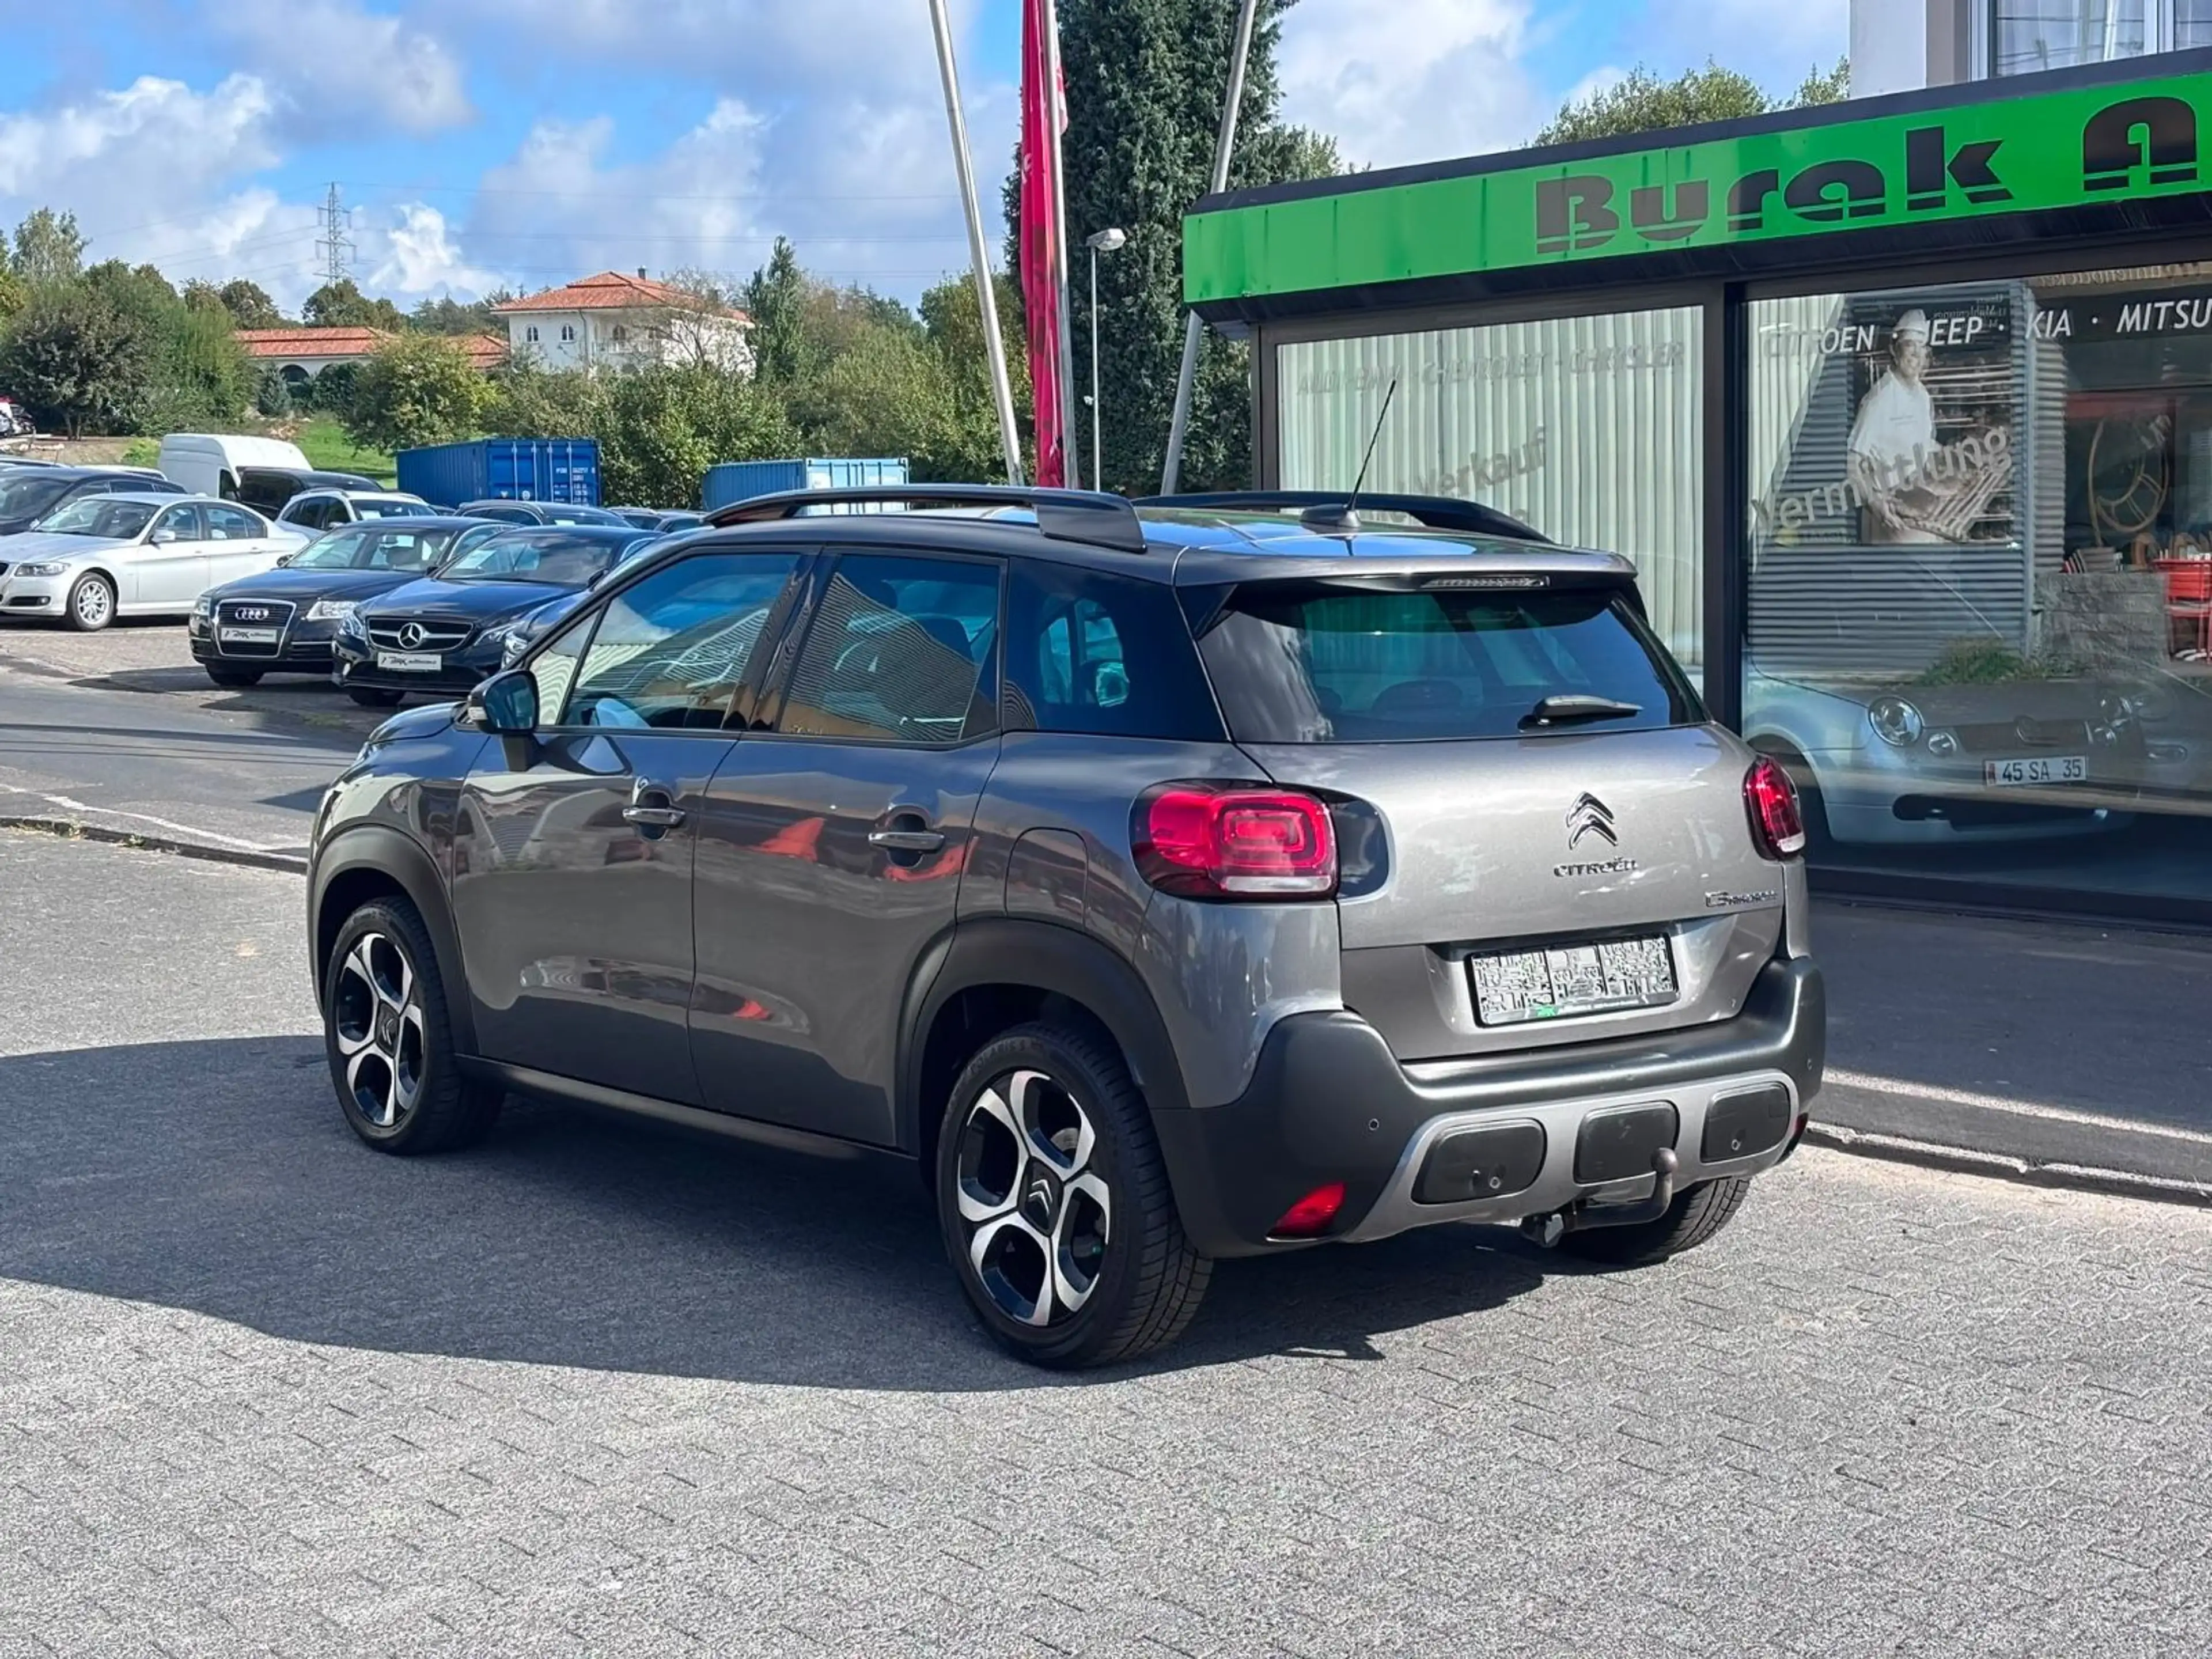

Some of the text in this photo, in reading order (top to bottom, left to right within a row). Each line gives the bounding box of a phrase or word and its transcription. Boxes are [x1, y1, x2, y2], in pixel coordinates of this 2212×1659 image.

[1536, 96, 2197, 255] Burak A
[2025, 309, 2071, 339] KIA
[2116, 298, 2212, 333] MITSU
[2002, 759, 2081, 782] 45 SA 35
